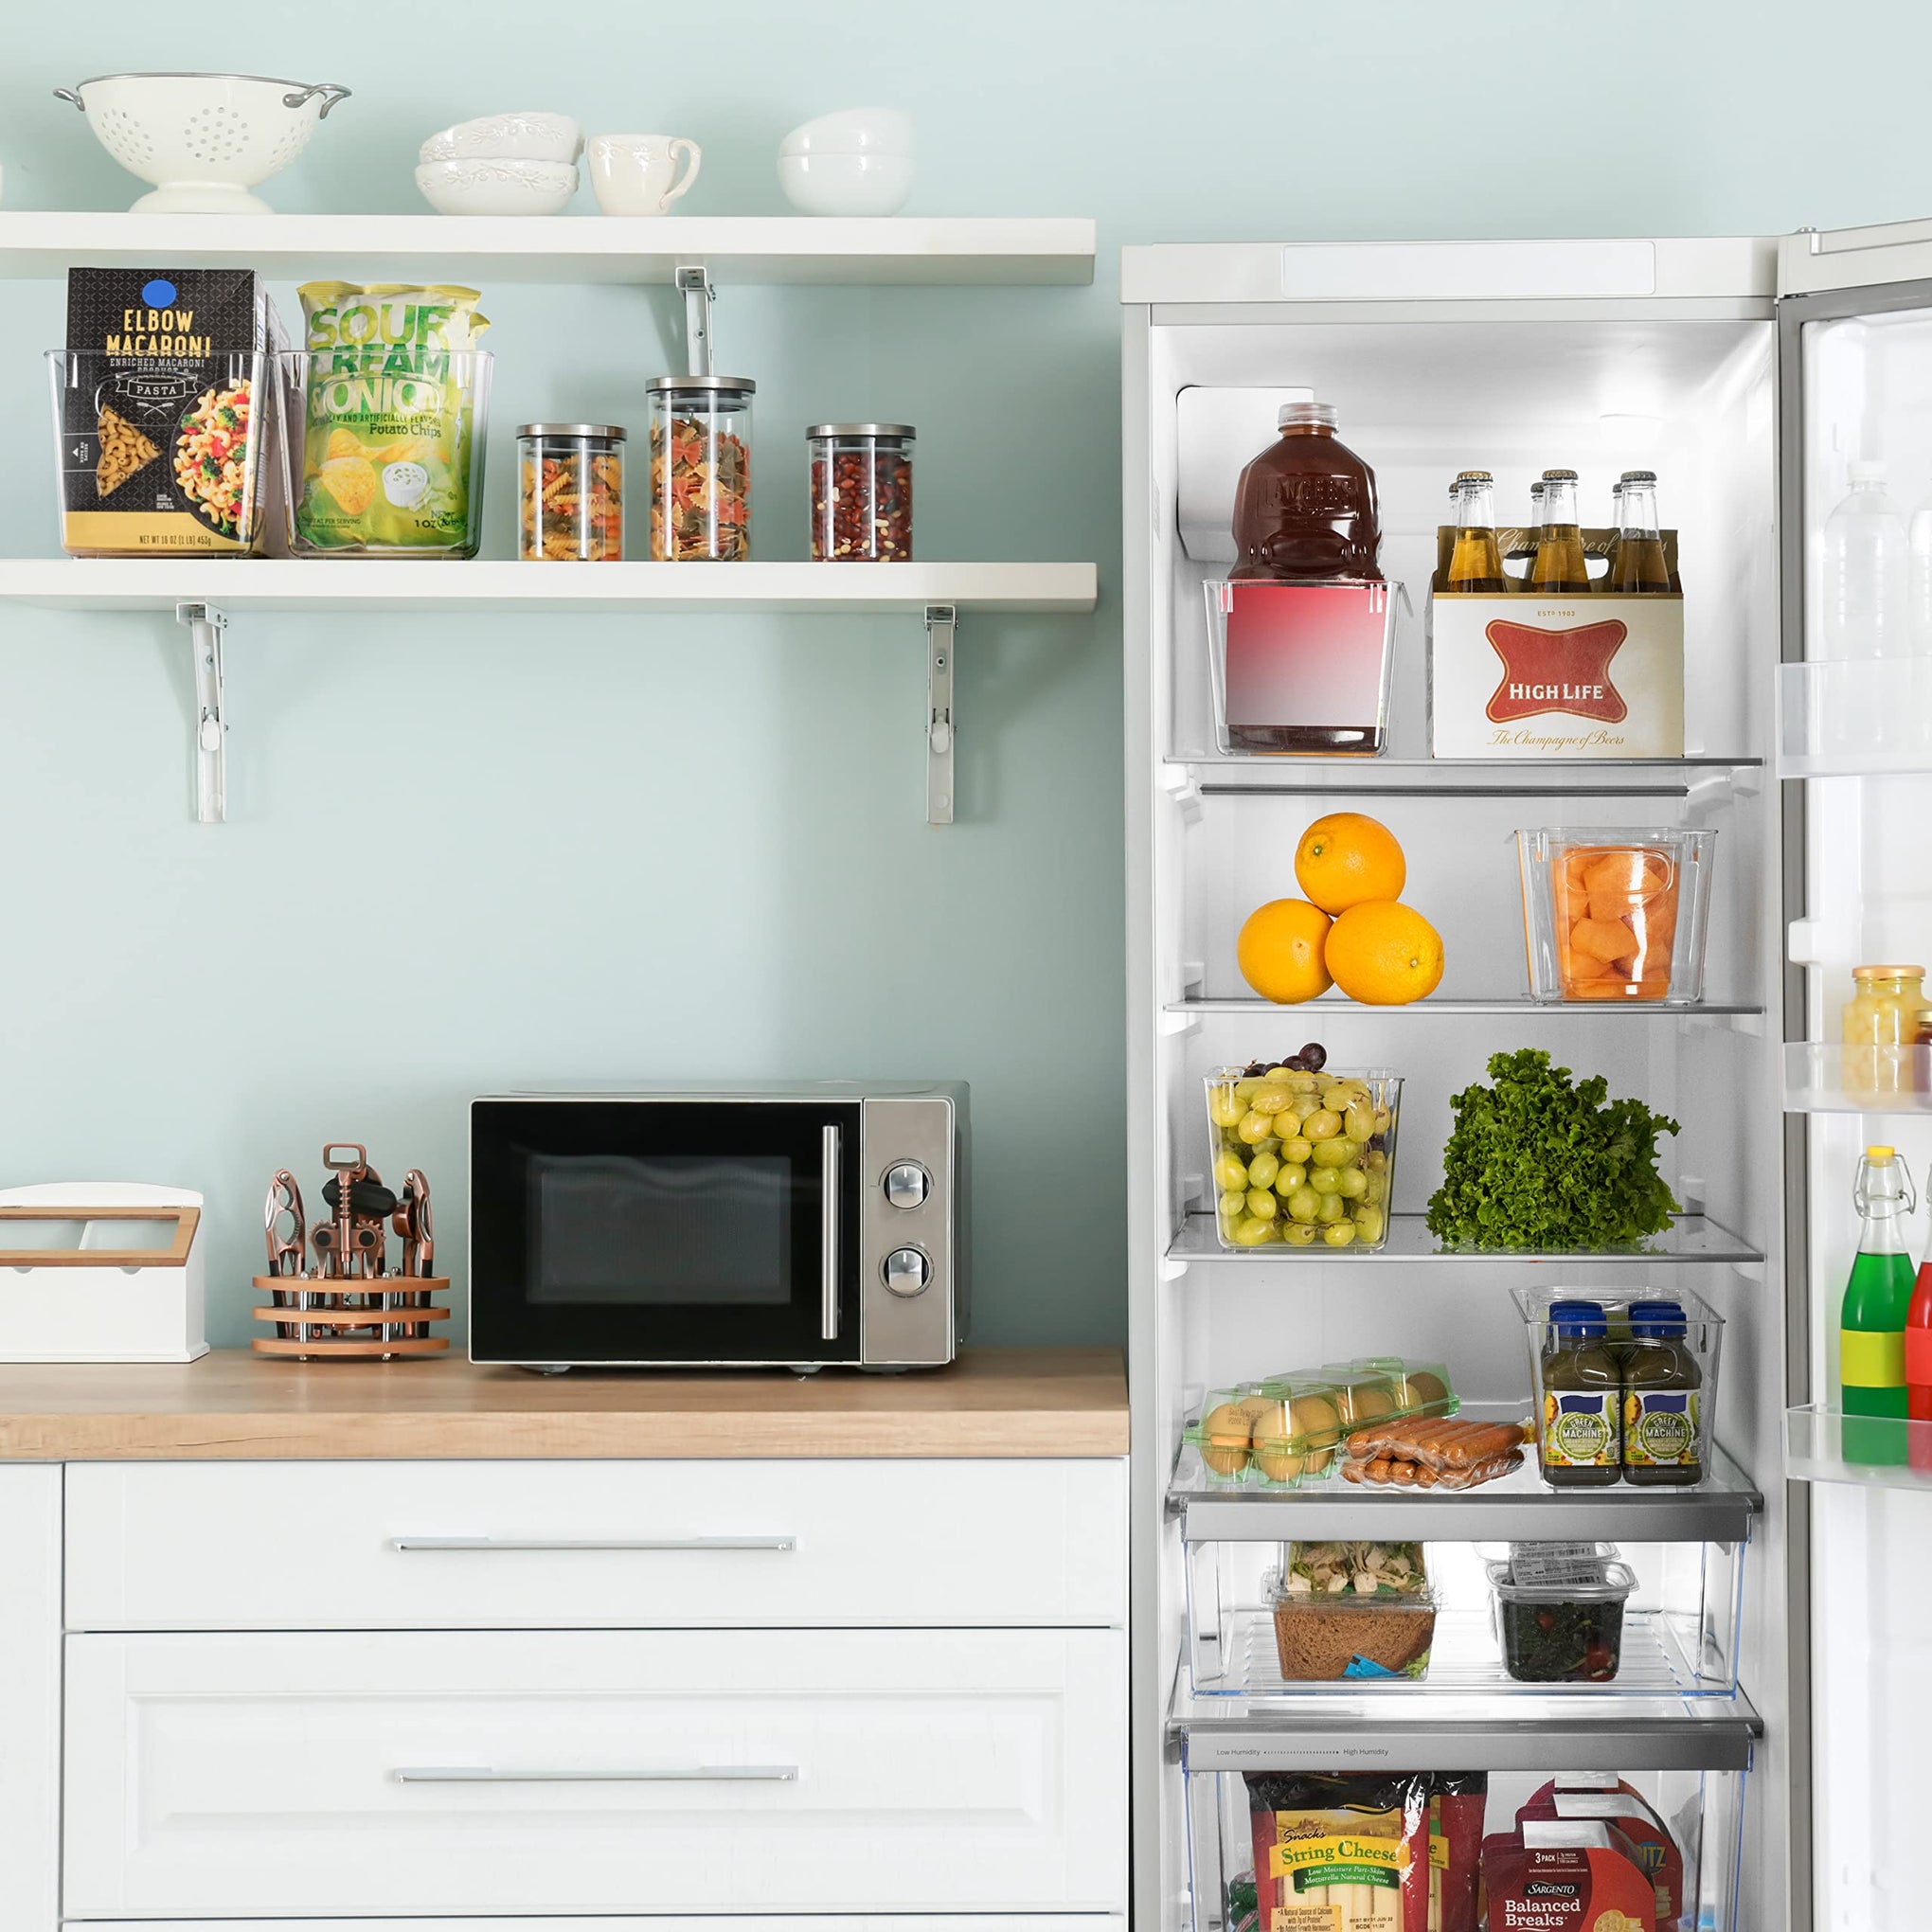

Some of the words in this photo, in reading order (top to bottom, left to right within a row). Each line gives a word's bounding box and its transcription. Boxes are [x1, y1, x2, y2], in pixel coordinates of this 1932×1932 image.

[124, 309, 193, 332] ELBOW
[309, 304, 456, 349] SOUR
[105, 334, 211, 358] MACARONI
[110, 358, 155, 367] ENRICHED
[157, 358, 206, 368] MACARONI
[311, 343, 451, 384] CREAM
[136, 385, 178, 396] PASTA
[342, 414, 357, 423] AND
[360, 413, 408, 423] ARTIFICIALLY
[369, 422, 408, 435] Potato
[410, 423, 441, 438] Chips
[139, 535, 150, 545] NET
[1510, 683, 1559, 700] HIGH
[1563, 683, 1604, 700] LIFE
[1486, 729, 1512, 744] The
[1513, 729, 1580, 751] Champagne
[1579, 731, 1593, 750] of
[1590, 729, 1625, 744] Beers
[1569, 1417, 1594, 1428] GREEN
[1653, 1417, 1677, 1428] GREEN
[1563, 1429, 1602, 1439] MACHINE
[1646, 1428, 1686, 1438] MACHINE
[1343, 1748, 1359, 1757] High
[1360, 1748, 1389, 1757] Humidity
[1283, 1828, 1327, 1844] Snacks
[1280, 1847, 1335, 1865] String
[1337, 1840, 1398, 1862] Cheese
[1535, 1852, 1541, 1864] 3
[1353, 1865, 1386, 1875] Part-Skim
[1304, 1875, 1340, 1885] Mozzarella
[1367, 1874, 1390, 1885] Cheese
[1528, 1883, 1575, 1895] SARGENTO
[1504, 1898, 1582, 1913] Balanced
[1505, 1913, 1565, 1926] Breaks
